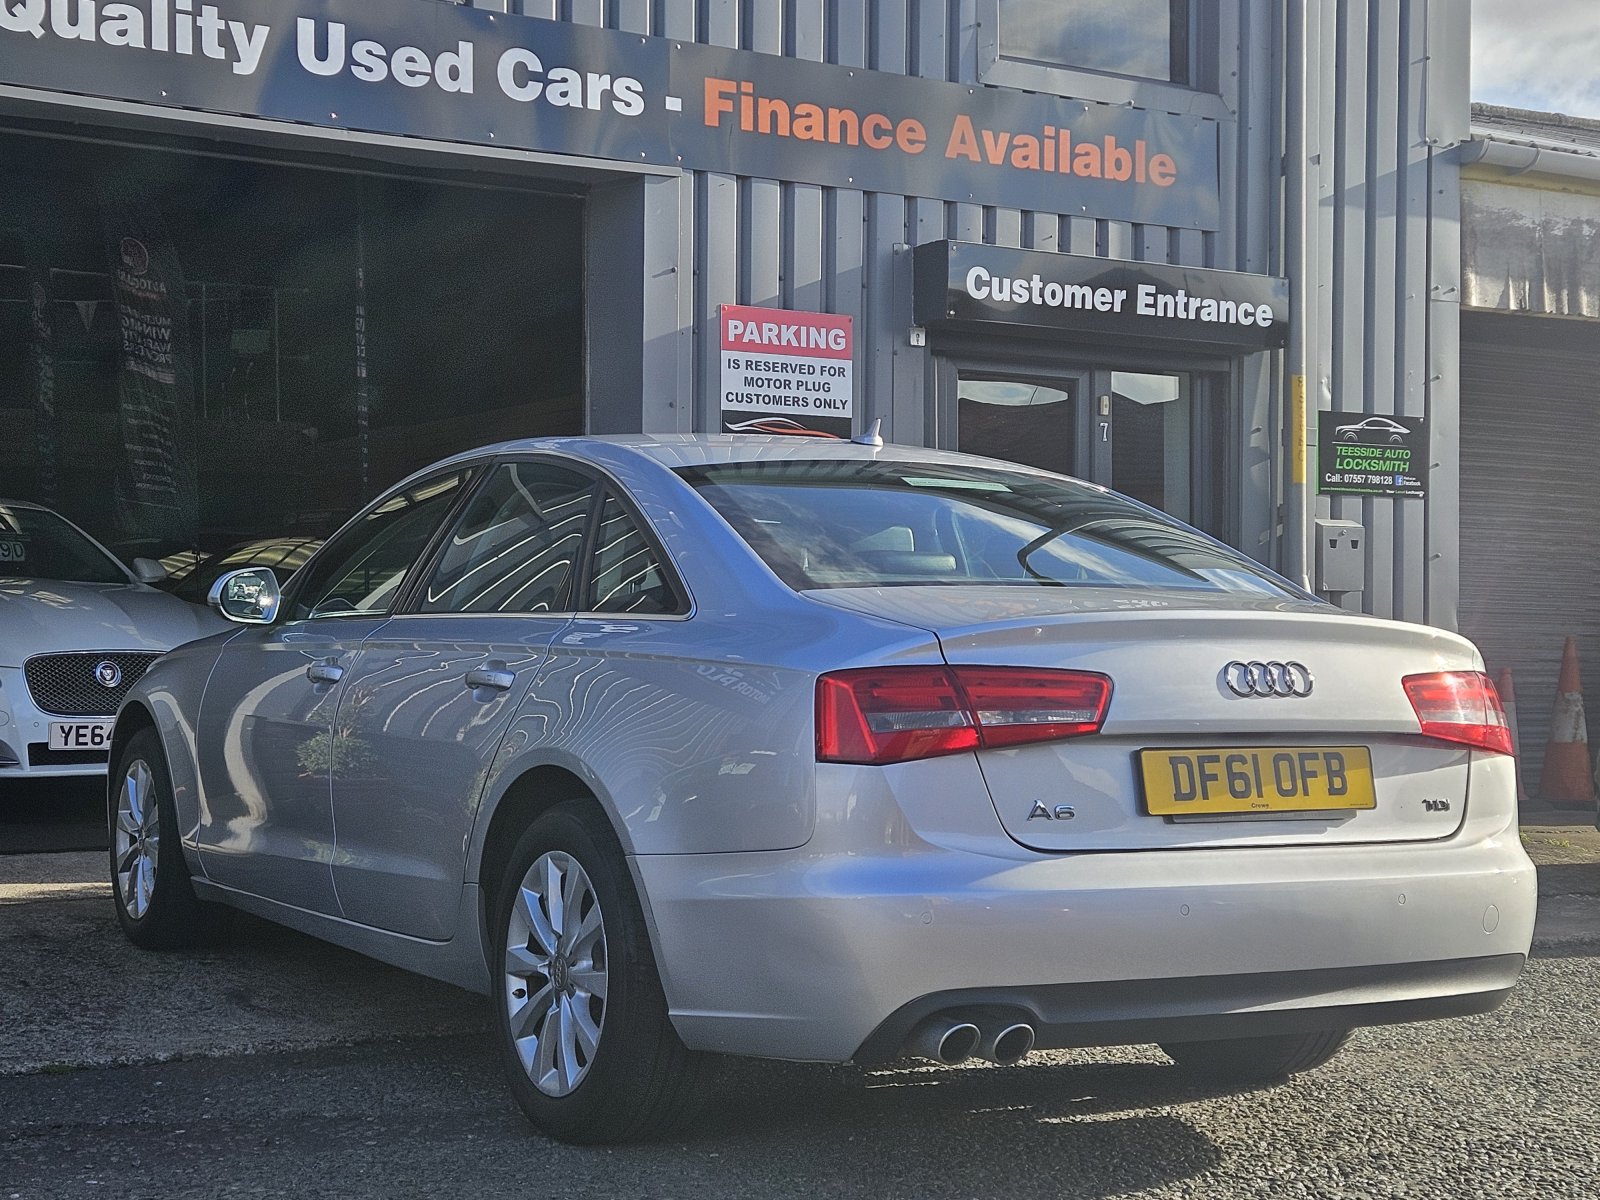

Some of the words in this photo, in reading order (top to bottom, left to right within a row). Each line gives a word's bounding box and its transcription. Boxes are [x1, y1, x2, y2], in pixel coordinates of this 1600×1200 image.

[298, 17, 474, 94] Used
[498, 47, 645, 116] Cars
[665, 96, 682, 111] -
[704, 76, 927, 155] Finance
[945, 114, 1177, 188] Available
[966, 265, 1127, 314] Customer
[1136, 283, 1274, 328] Entrance
[728, 319, 846, 351] PARKING
[727, 358, 741, 370] IS
[745, 359, 816, 376] RESERVED
[820, 365, 846, 378] FOR
[743, 376, 792, 391] MOTOR
[796, 380, 831, 393] PLUG
[725, 391, 809, 408] CUSTOMERS
[813, 397, 848, 410] ONLY
[1099, 422, 1109, 442] 7
[1336, 446, 1383, 458] TEESSIDE
[1384, 449, 1411, 459] AUTO
[1335, 458, 1410, 472] LOCKSMITH
[1325, 473, 1343, 483] Call:
[1344, 474, 1366, 484] 07557
[1168, 754, 1264, 801] DF61
[1273, 752, 1348, 798] OFB
[1027, 799, 1076, 822] A6
